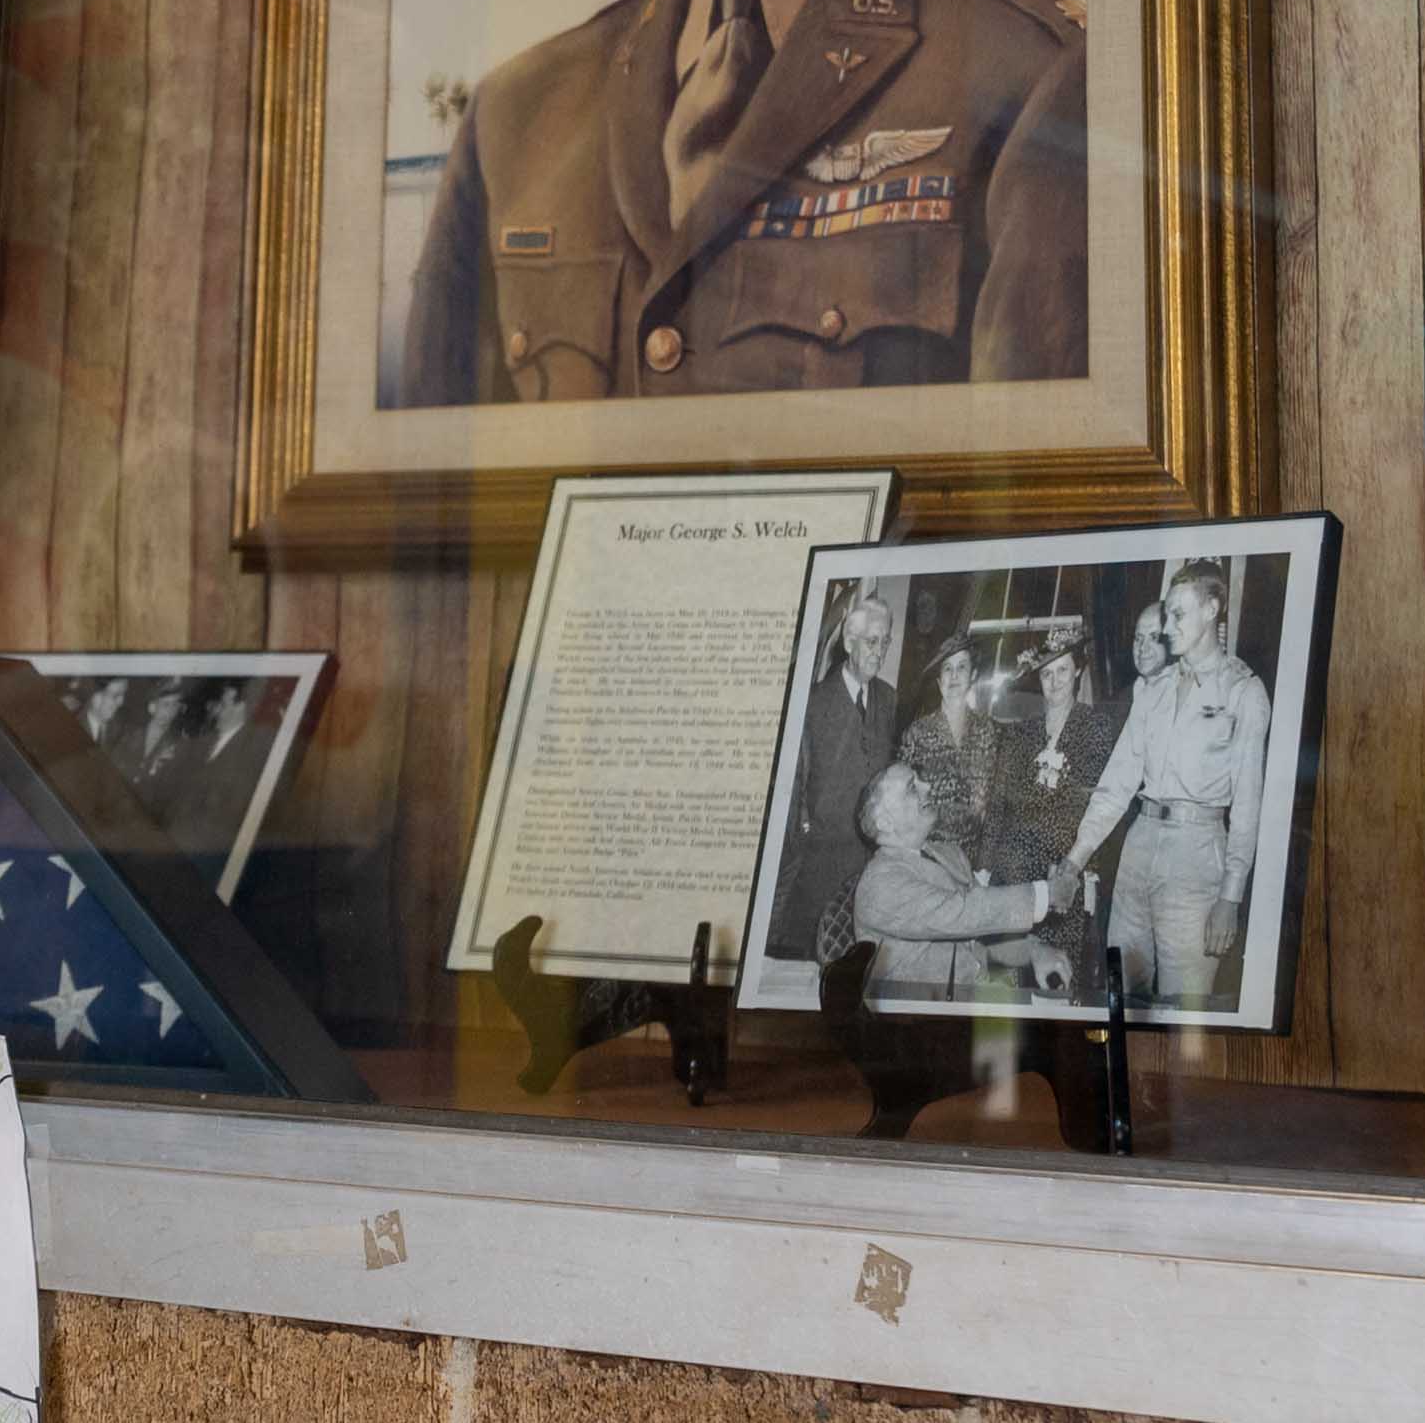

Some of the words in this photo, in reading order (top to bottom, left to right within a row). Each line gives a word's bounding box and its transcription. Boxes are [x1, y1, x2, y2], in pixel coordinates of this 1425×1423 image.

[617, 524, 664, 542] Major
[669, 522, 727, 541] George
[732, 522, 747, 539] S.
[754, 521, 808, 539] Welch
